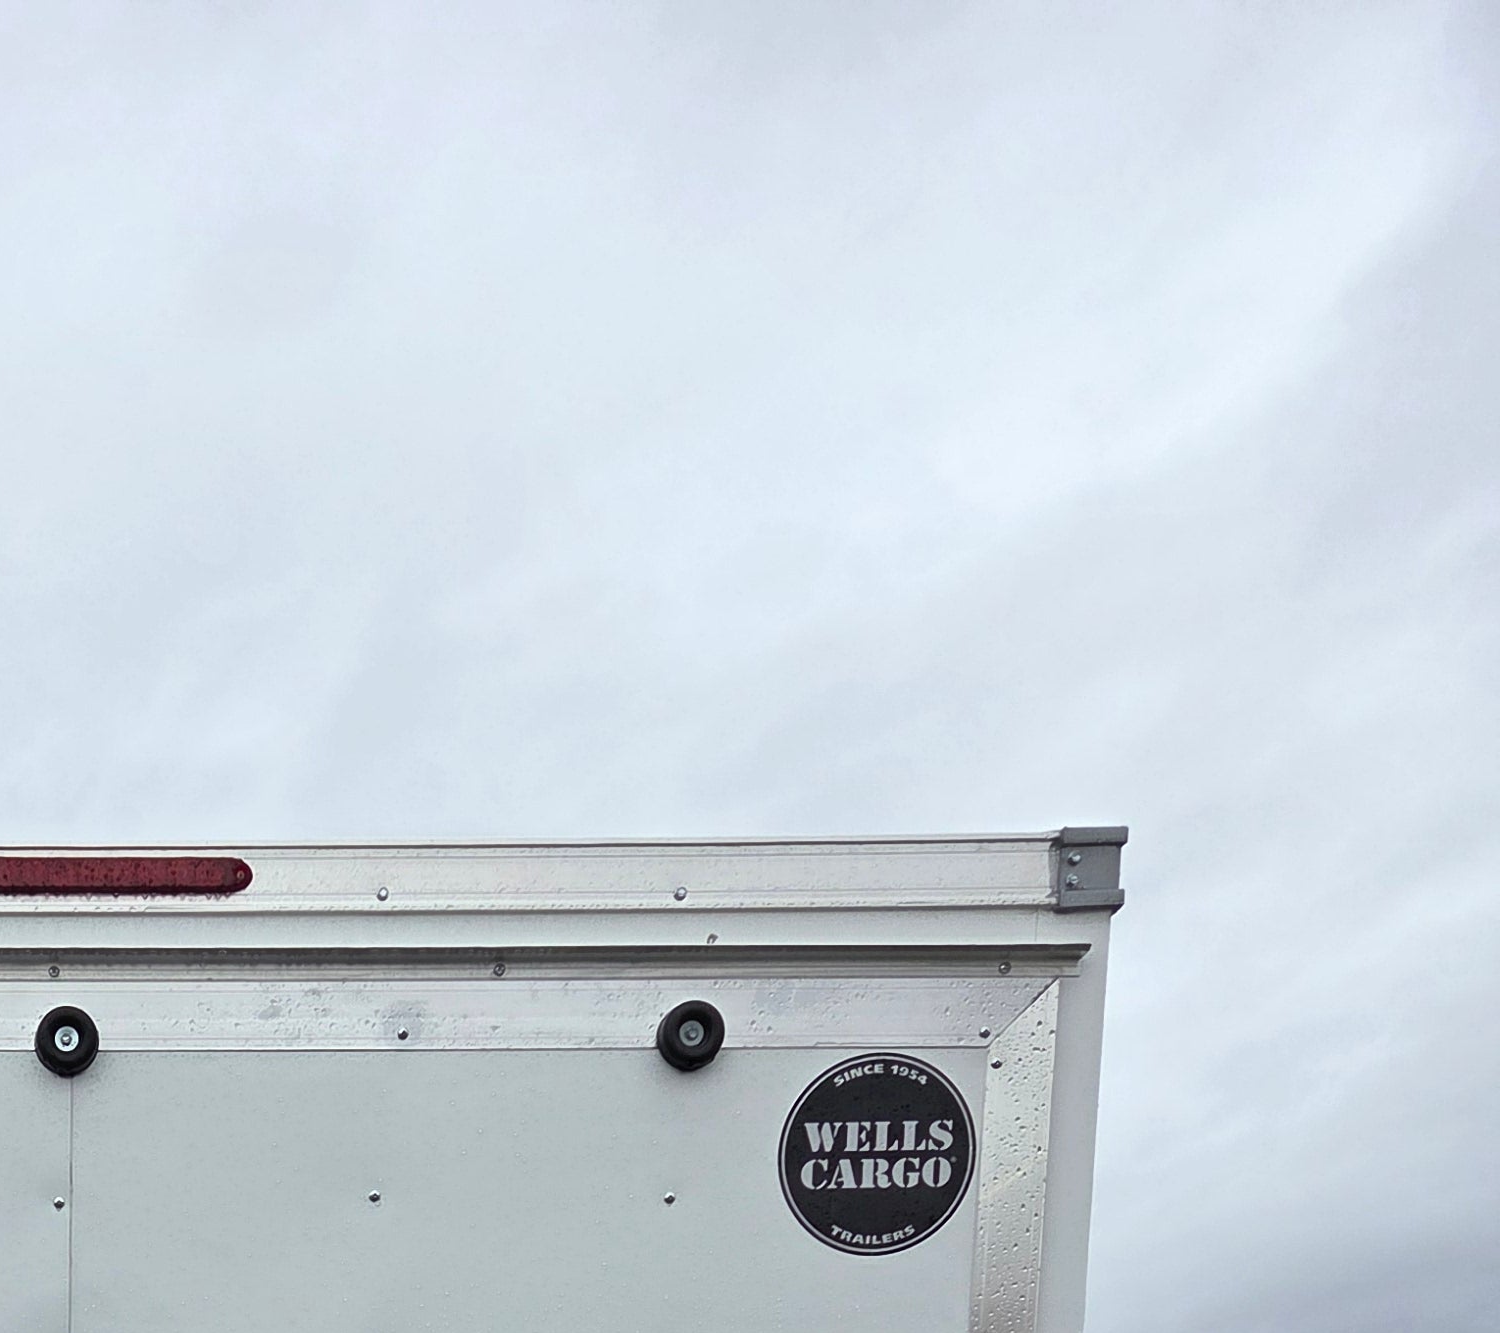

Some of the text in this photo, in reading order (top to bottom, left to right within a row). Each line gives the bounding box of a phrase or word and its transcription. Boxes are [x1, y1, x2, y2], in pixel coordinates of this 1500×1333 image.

[833, 1063, 929, 1087] SINCE 1954
[803, 1119, 954, 1152] WELLS
[800, 1156, 953, 1190] CARGO
[830, 1224, 916, 1245] TRAILERS
